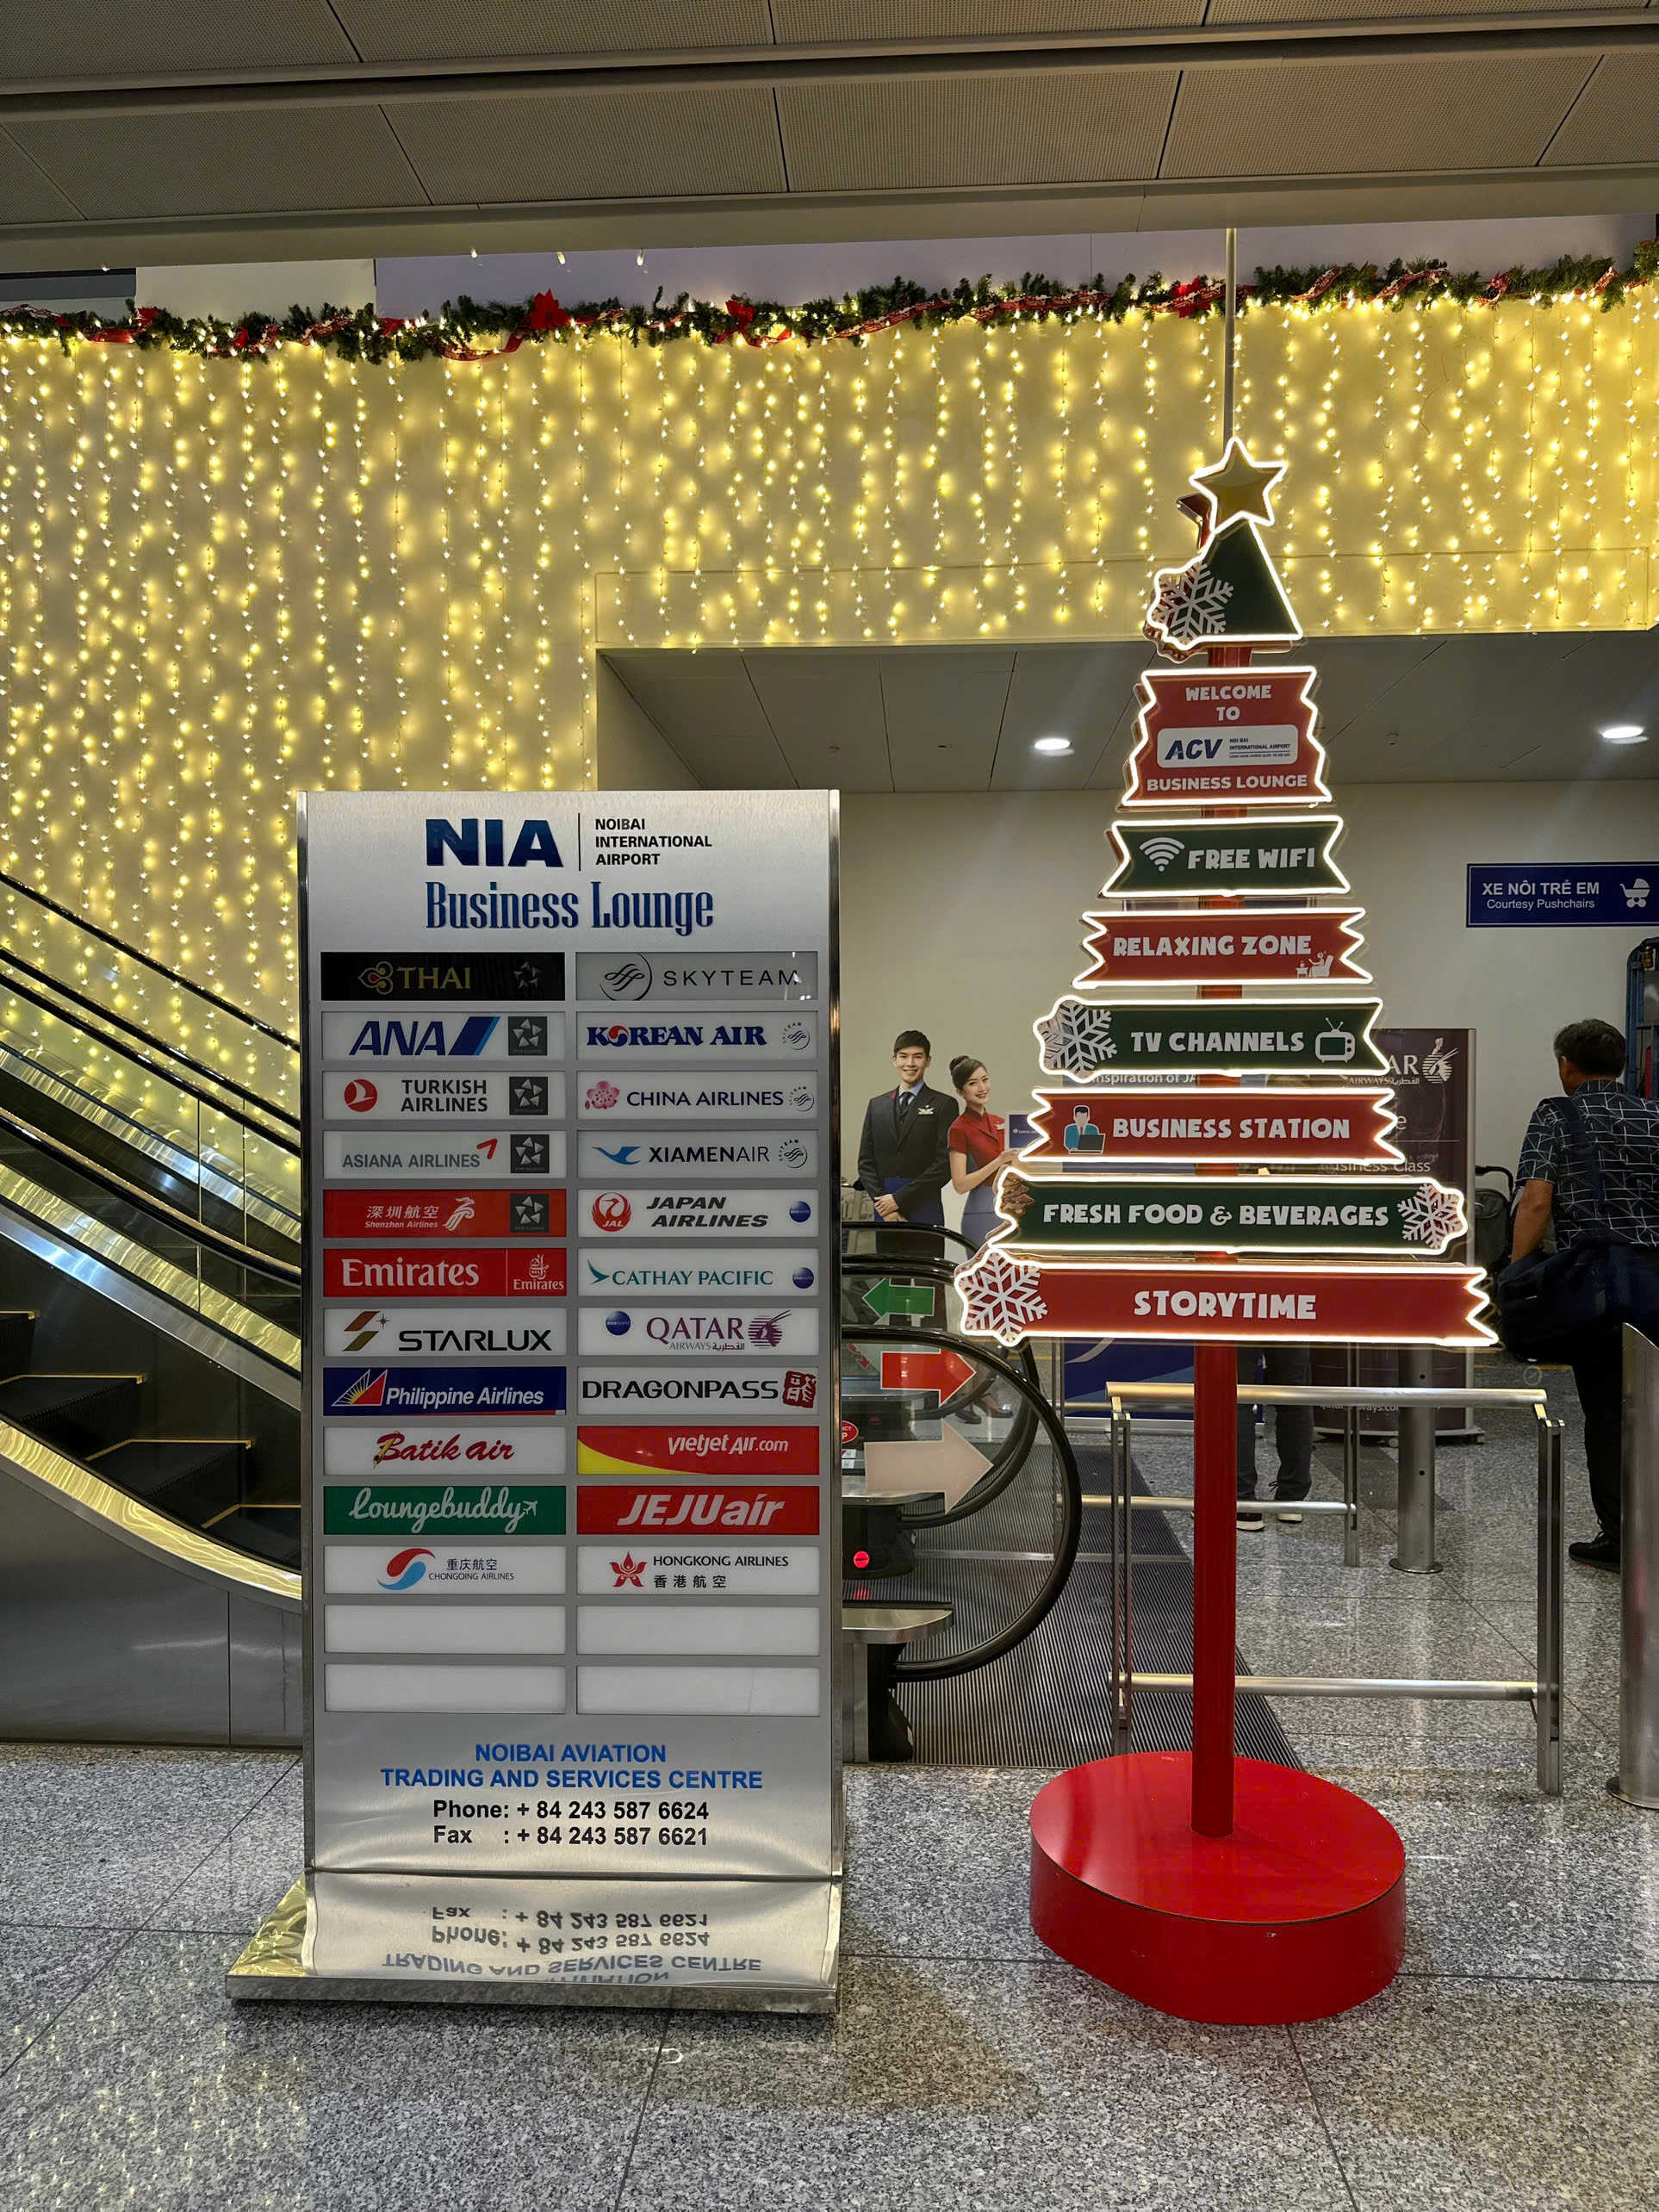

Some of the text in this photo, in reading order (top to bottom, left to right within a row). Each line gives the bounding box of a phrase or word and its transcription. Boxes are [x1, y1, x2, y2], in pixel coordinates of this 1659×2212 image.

[1185, 685, 1271, 701] WELCOME
[1216, 706, 1240, 721] TO
[1164, 738, 1223, 761] ACV
[1146, 774, 1308, 792] BUSINESS LOUNGE
[595, 818, 645, 830] NOIBAI
[426, 818, 563, 867] NIA
[595, 836, 712, 848] INTERNATIONAL
[595, 853, 661, 866] AIRPORT
[1187, 847, 1316, 870] FREE WIFI
[1482, 882, 1503, 896] XE
[1576, 881, 1600, 895] EM
[426, 881, 714, 936] Business Lounge
[1487, 898, 1595, 911] Courtesy Pushchairs
[1113, 935, 1311, 957] RELAXING ZONE
[397, 966, 471, 989] THAI
[663, 970, 799, 986] SKYTEAM
[348, 1020, 453, 1056] ANA
[587, 1026, 704, 1047] KOREAN
[710, 1026, 767, 1047] AIR
[1131, 1031, 1305, 1053] TV CHANNELS
[401, 1079, 488, 1095] TURKISH
[401, 1097, 488, 1113] AIRLINES
[626, 1091, 692, 1107] CHINA
[695, 1090, 784, 1106] AIRLINES
[1113, 1118, 1350, 1139] BUSINESS STATION
[342, 1154, 481, 1168] ASIANA AIRLINES
[649, 1146, 770, 1163] XIAMENAIR
[646, 1196, 727, 1209] JAPAN
[366, 1205, 439, 1219] 深圳航空
[1043, 1203, 1389, 1227] FRESH FOOD & BEVERAGES
[364, 1221, 438, 1229] Shenzhen Airlines
[650, 1215, 768, 1227] AIRLINES
[341, 1257, 480, 1287] Emirates
[612, 1271, 774, 1285] CATHAY PACIFIC
[513, 1278, 565, 1290] Emirates
[1134, 1290, 1317, 1320] STORYTIME
[646, 1316, 745, 1345] QATAR
[398, 1330, 553, 1351] STARLUX
[668, 1342, 711, 1351] AIRWAYS
[386, 1387, 544, 1409] Philippine Airlines
[581, 1380, 779, 1399] DRAGONPASS
[375, 1432, 515, 1463] Batik air
[349, 1486, 527, 1534] Loungebuddy
[446, 1558, 498, 1571] 重庆航空
[652, 1556, 789, 1567] HONGKONG AIRLINES
[480, 1572, 515, 1581] AIRLINES
[653, 1575, 727, 1589] 香港航空
[475, 1743, 667, 1763] NOIBAI AVIATION
[381, 1768, 763, 1790] TRADING AND SERVICES CENTRE
[432, 1799, 709, 1821] Phone: + 84 243 587 6624
[433, 1825, 473, 1844] Fax
[517, 1830, 530, 1843] +
[537, 1826, 562, 1846] 84
[569, 1827, 606, 1846] 243
[613, 1827, 650, 1847] 587
[658, 1827, 708, 1847] 6621
